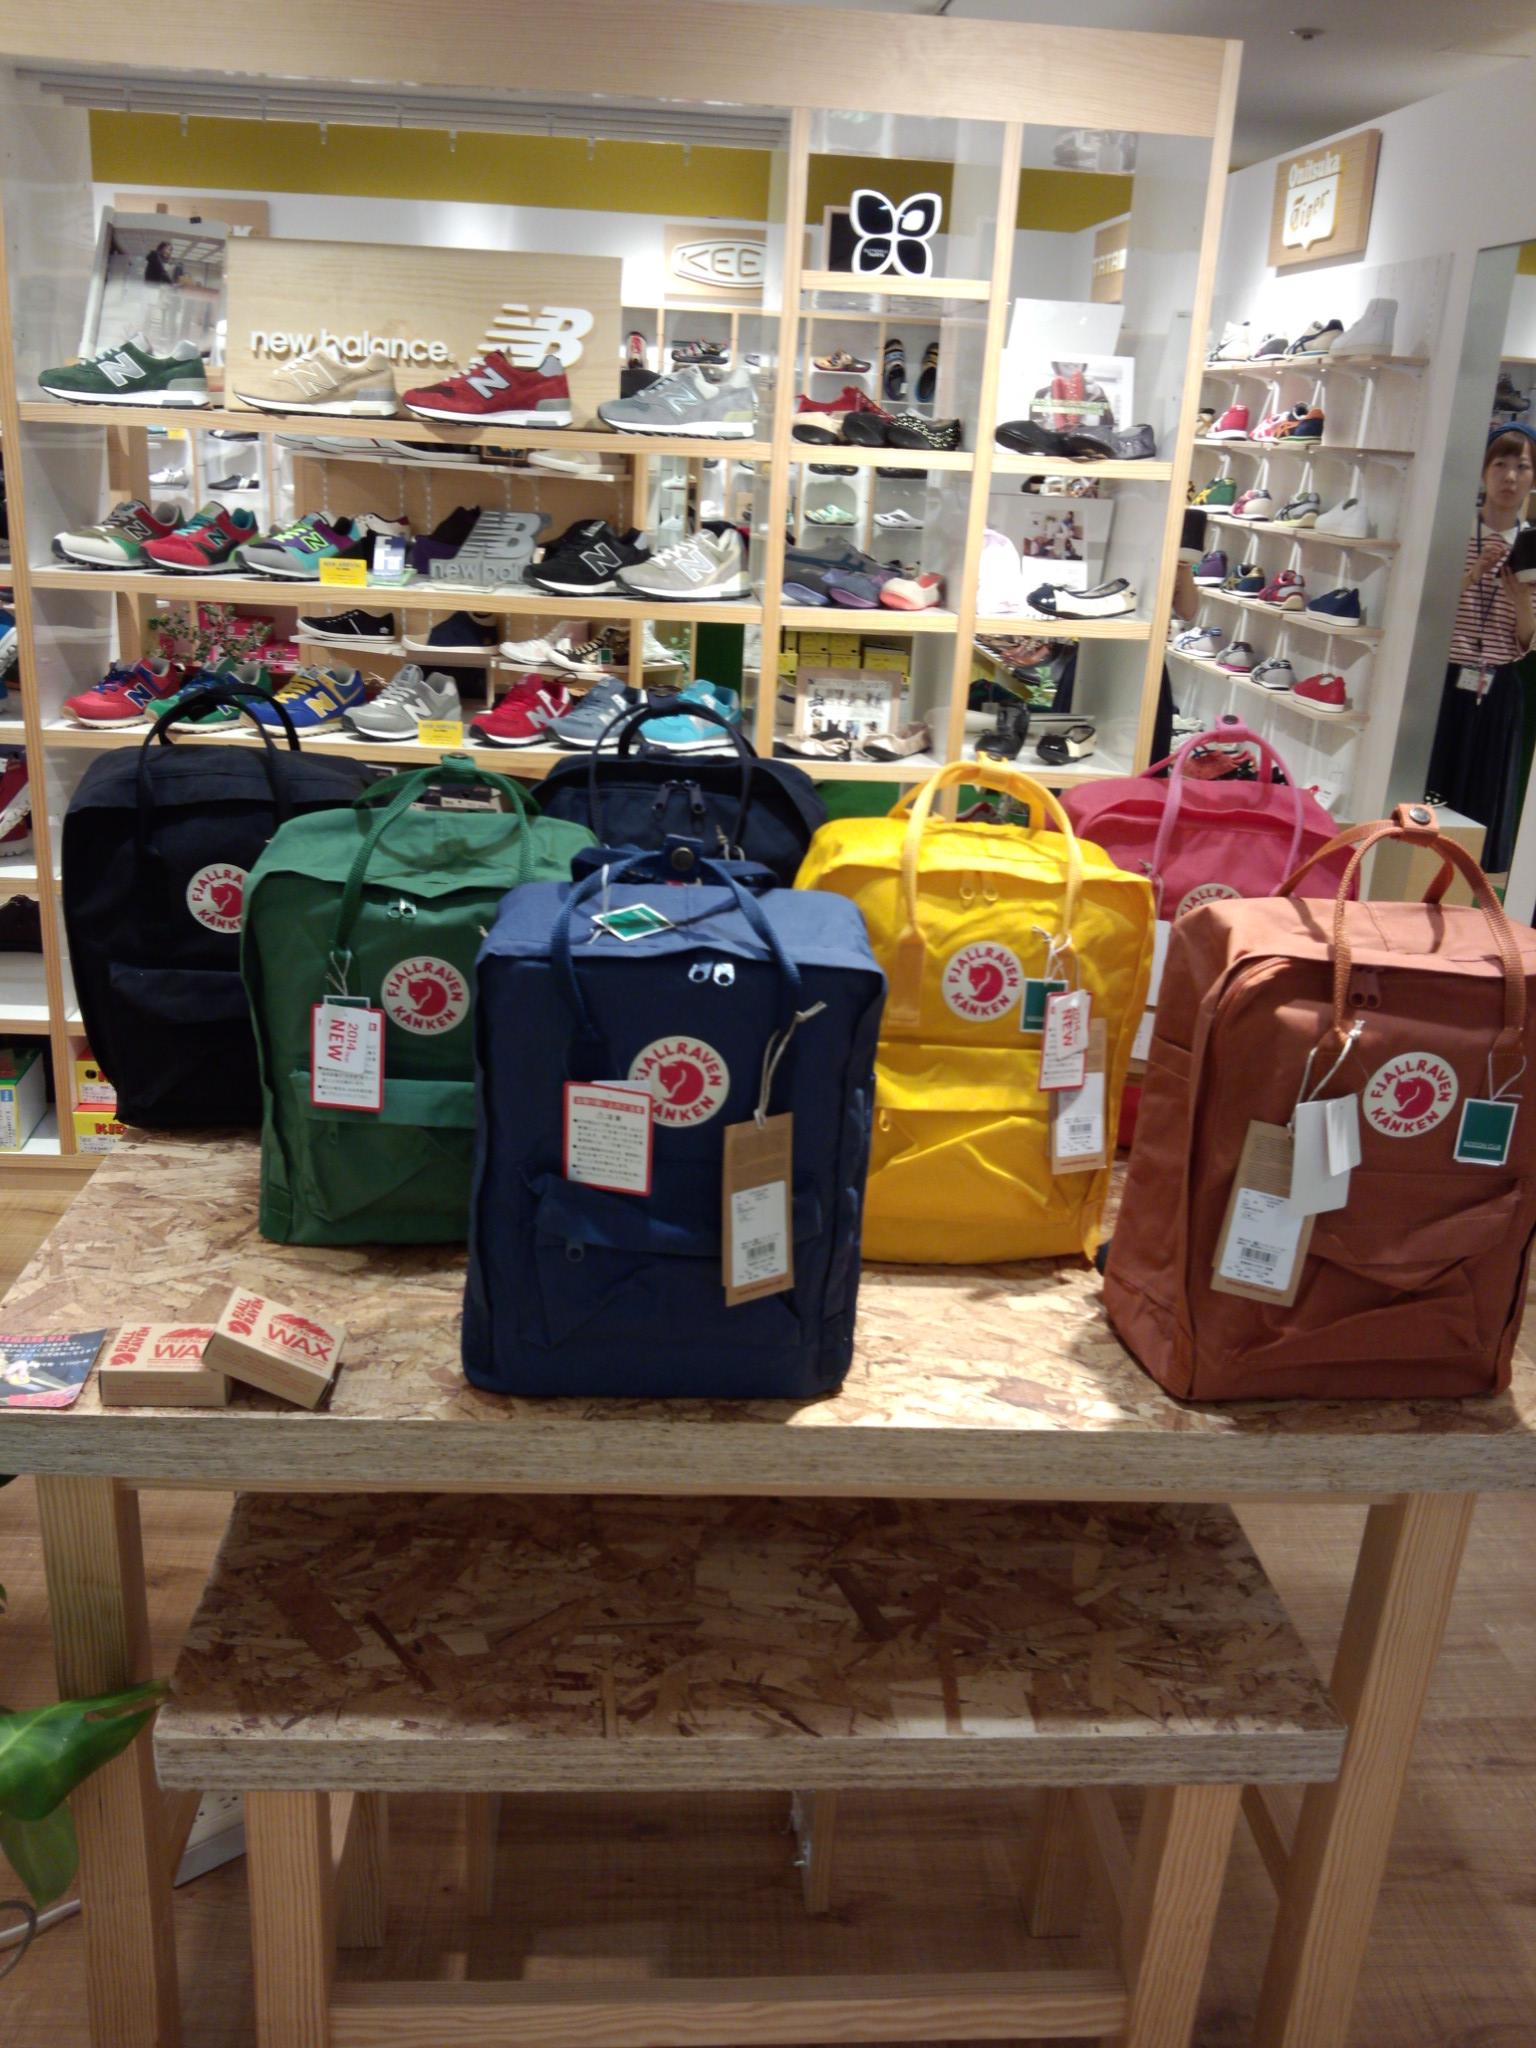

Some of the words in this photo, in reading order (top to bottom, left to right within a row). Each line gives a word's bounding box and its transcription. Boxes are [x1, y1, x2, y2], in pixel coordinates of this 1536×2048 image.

[680, 247, 763, 277] KEE
[250, 329, 316, 353] new
[192, 868, 244, 902] FJALLRA
[327, 1019, 346, 1062] NEW
[652, 1095, 716, 1121] ANKEN
[154, 1343, 202, 1359] WA
[267, 1323, 333, 1362] WAX
